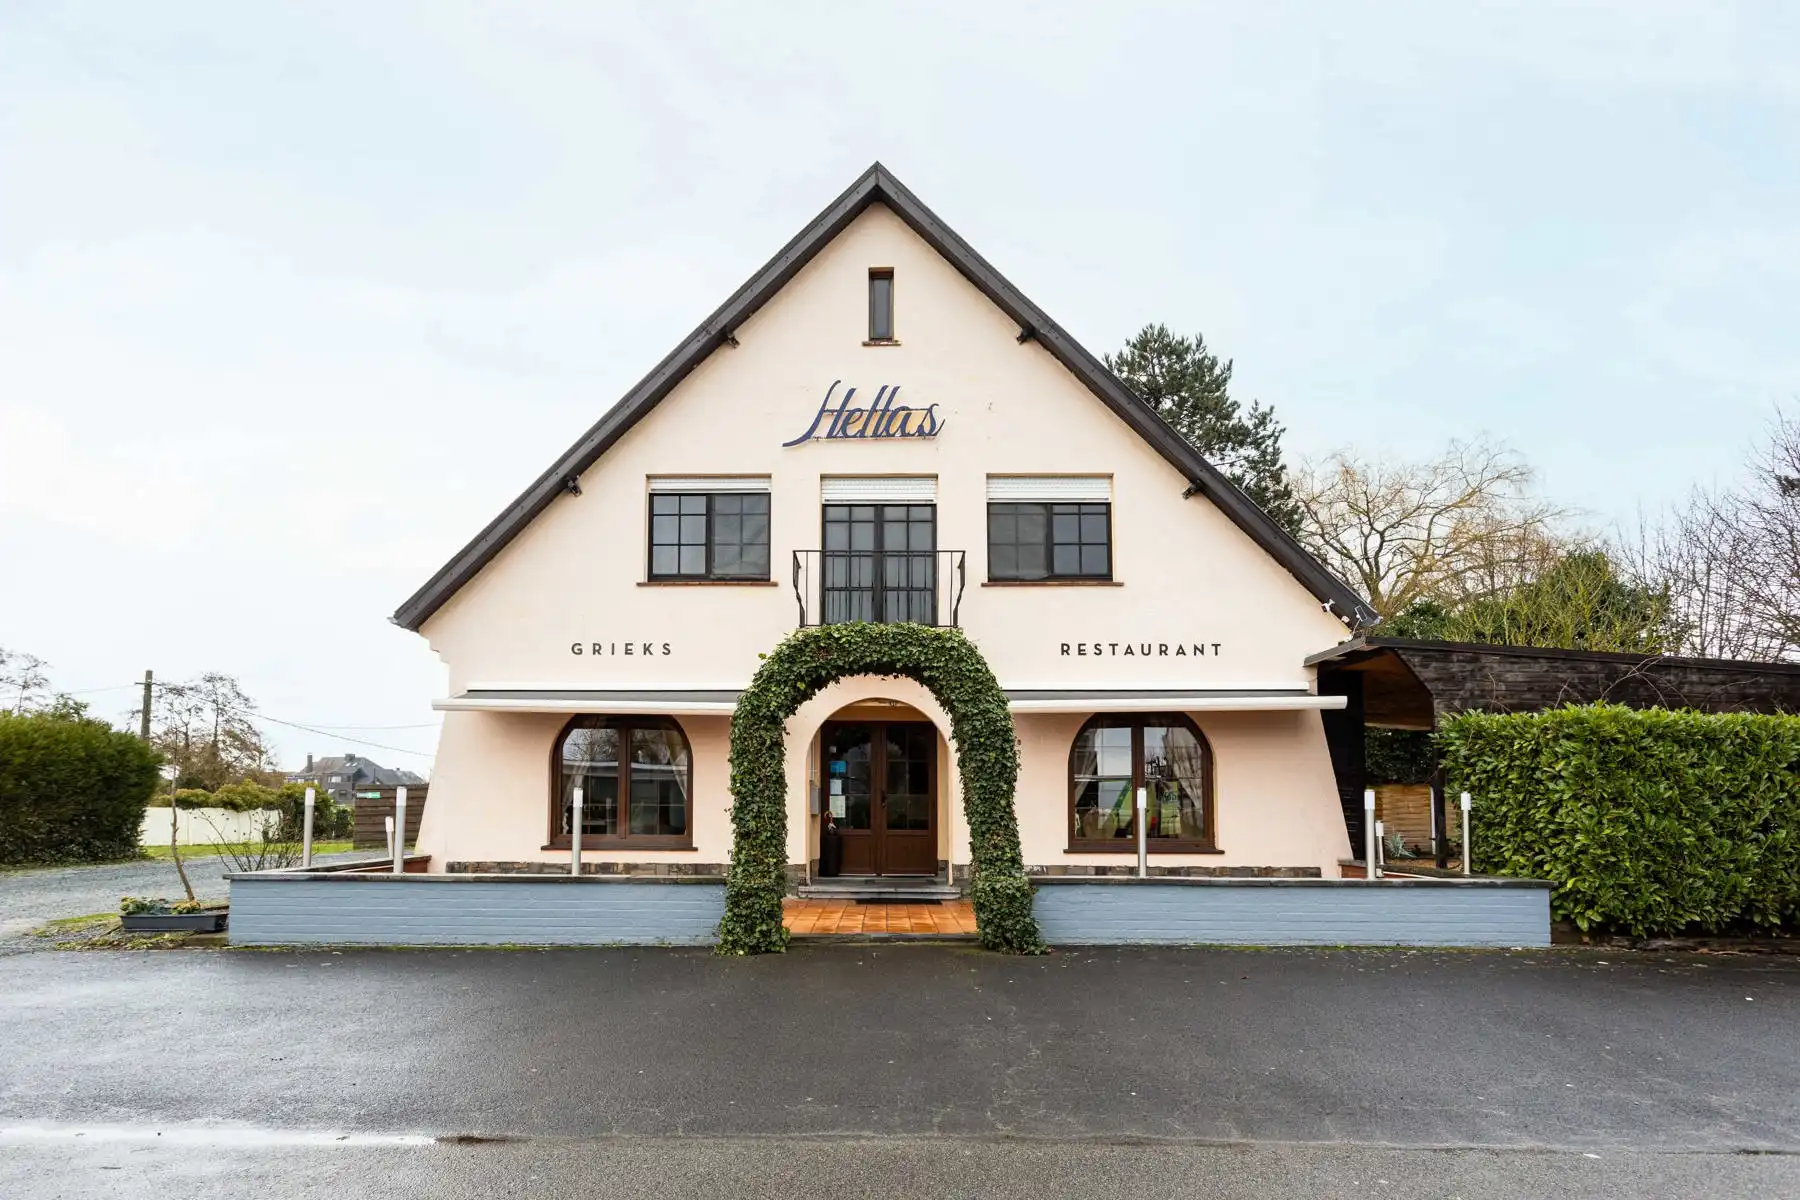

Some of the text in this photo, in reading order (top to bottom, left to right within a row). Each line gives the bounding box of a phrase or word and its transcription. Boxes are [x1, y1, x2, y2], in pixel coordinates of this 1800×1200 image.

[782, 379, 946, 447] Hellas
[571, 642, 1222, 656] GRIEKS RESTAURANT
